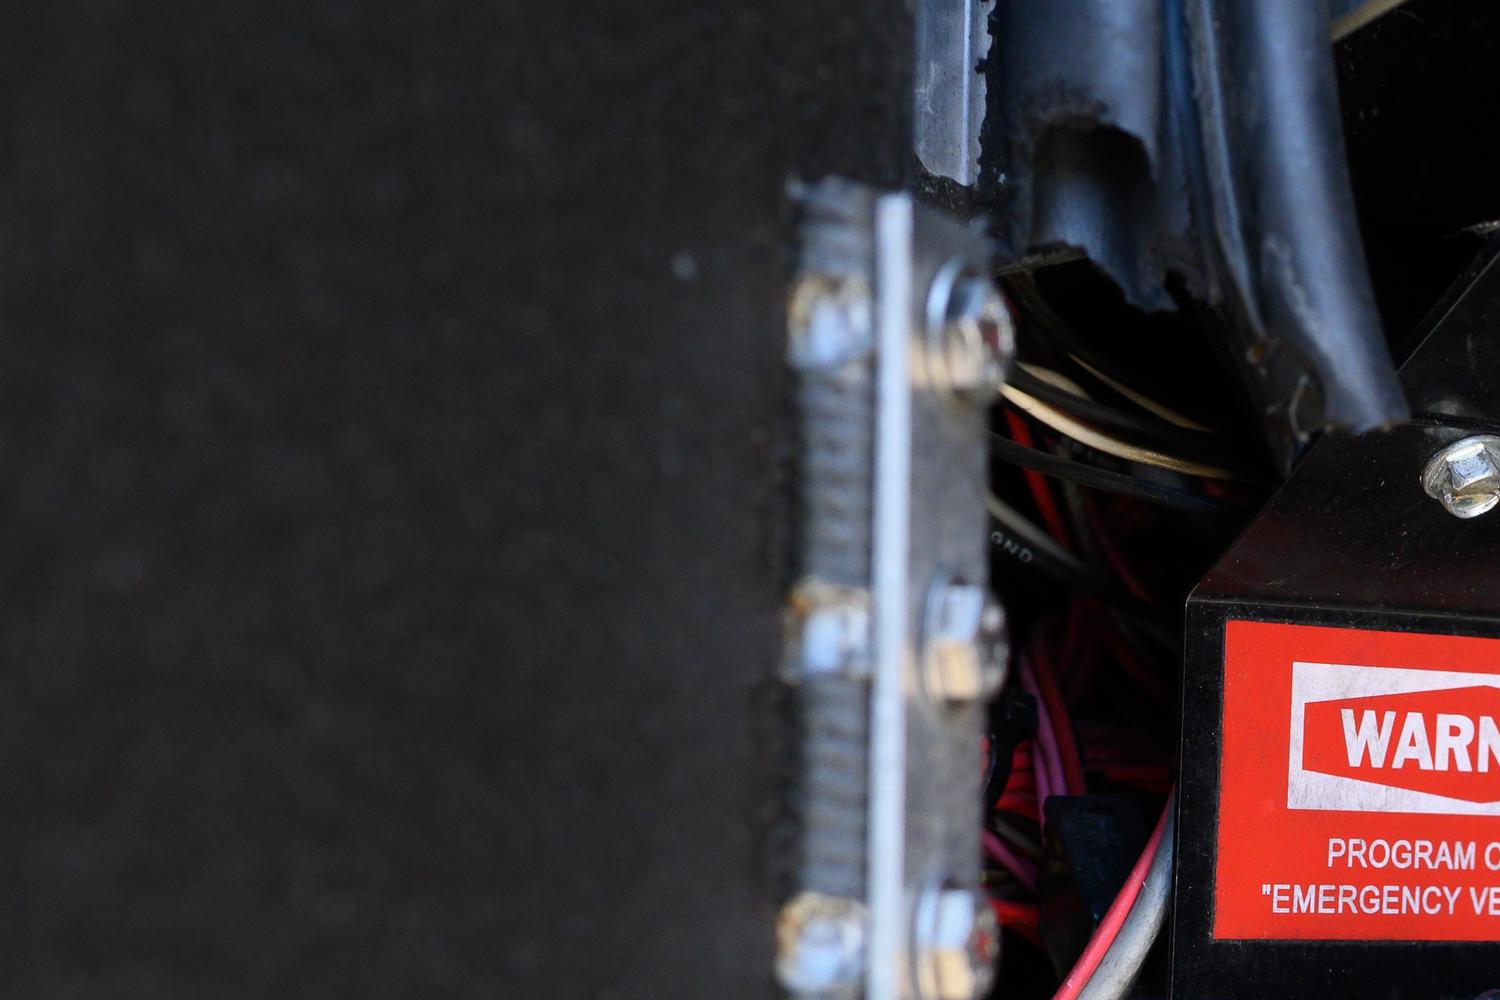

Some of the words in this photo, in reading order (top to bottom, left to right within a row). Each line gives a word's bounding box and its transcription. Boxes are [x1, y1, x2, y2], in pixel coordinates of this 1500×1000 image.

[990, 530, 1033, 563] GND
[1327, 838, 1476, 870] PROGRAM
[1262, 883, 1462, 915] "EMERGENCY
